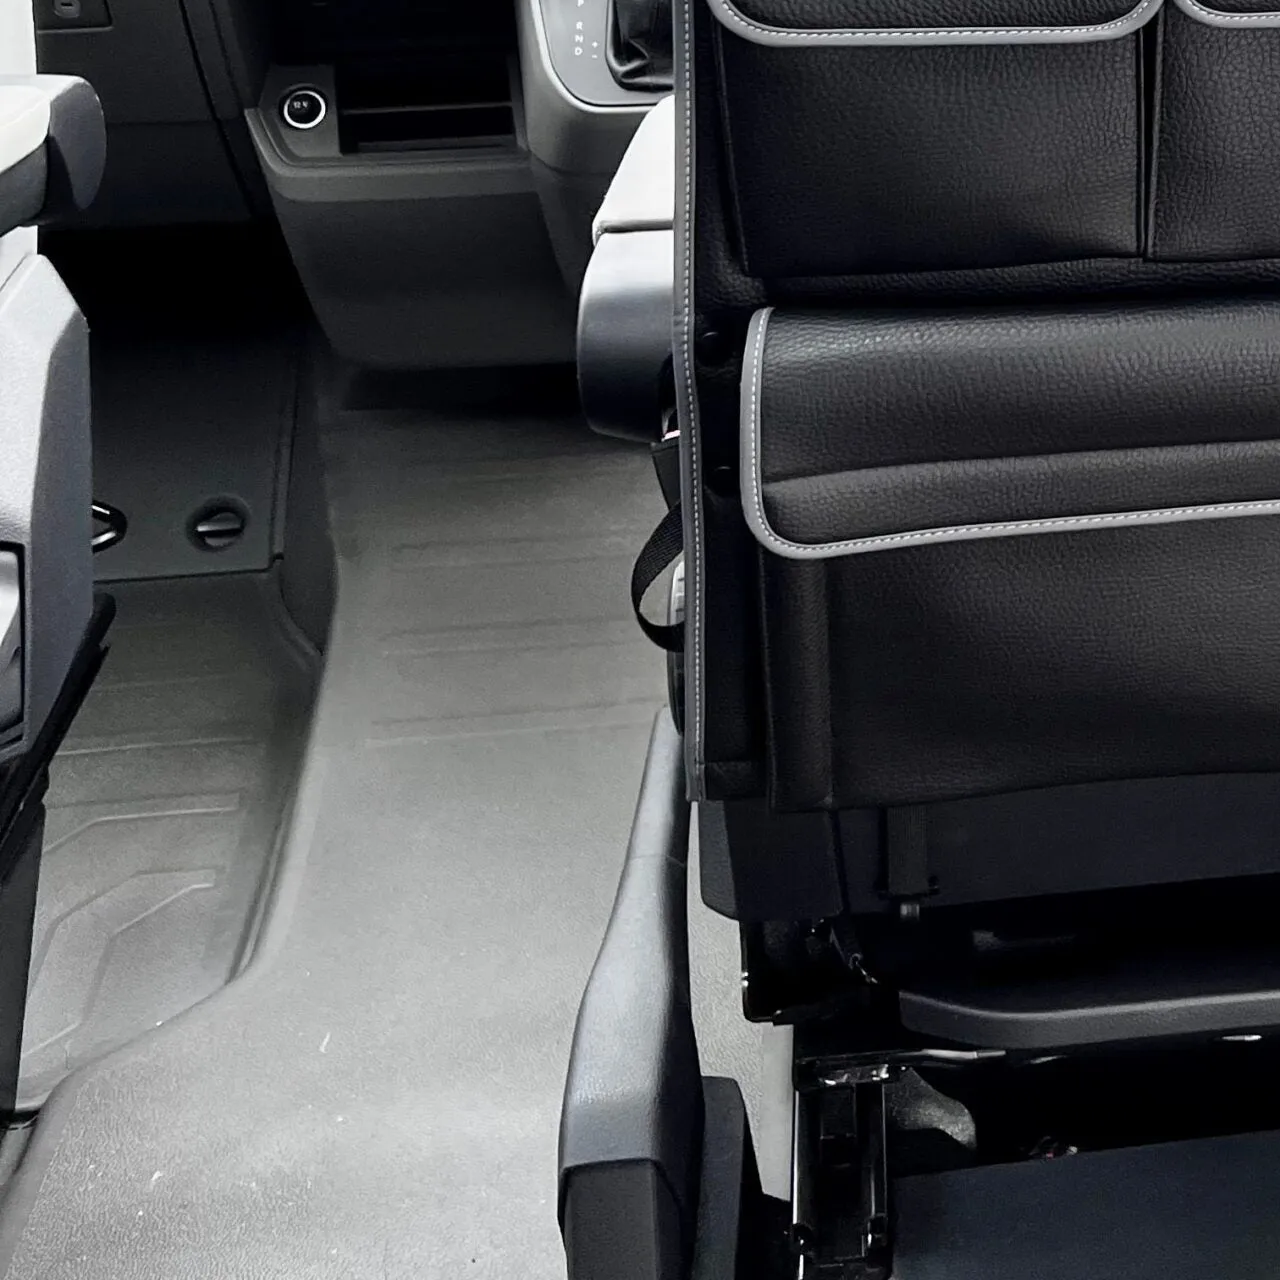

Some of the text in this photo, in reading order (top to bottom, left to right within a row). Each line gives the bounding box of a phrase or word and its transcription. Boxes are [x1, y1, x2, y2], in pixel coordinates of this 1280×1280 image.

[575, 21, 583, 31] R
[574, 34, 584, 43] N
[574, 46, 583, 56] D
